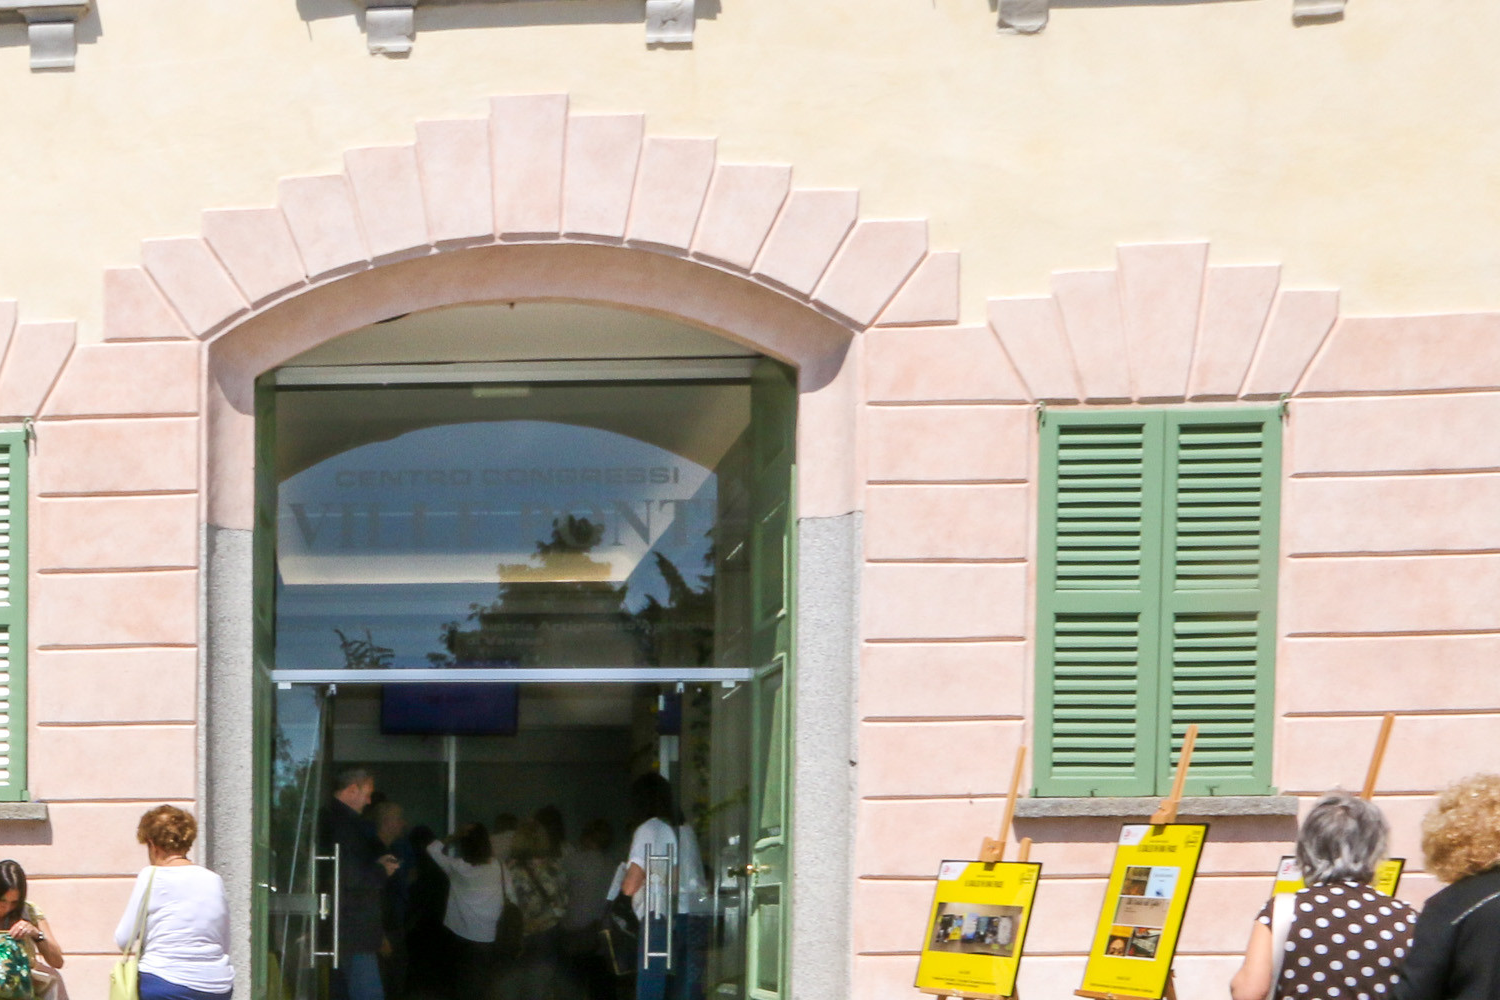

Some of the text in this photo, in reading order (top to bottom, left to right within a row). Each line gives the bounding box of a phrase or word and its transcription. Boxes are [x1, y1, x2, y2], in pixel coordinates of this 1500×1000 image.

[335, 465, 680, 489] CENTRO CONGRESSI
[289, 498, 718, 549] VILLE PONT
